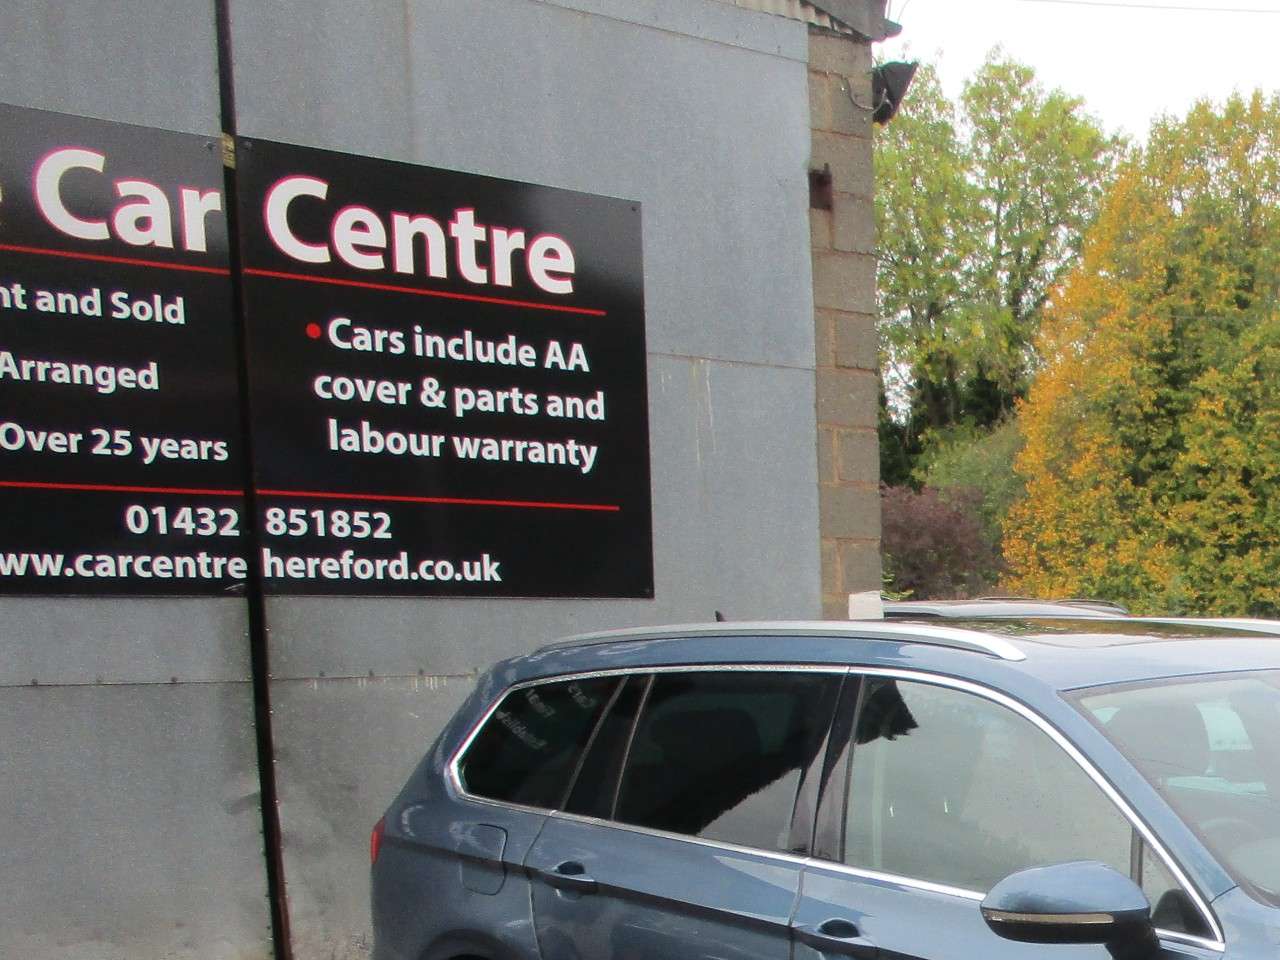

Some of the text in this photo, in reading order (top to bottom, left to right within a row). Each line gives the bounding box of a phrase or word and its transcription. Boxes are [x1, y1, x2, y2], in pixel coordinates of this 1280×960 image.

[33, 147, 577, 294] Car Centre
[35, 287, 102, 317] and
[110, 291, 186, 325] Sold
[327, 317, 591, 373] Cars include AA
[0, 350, 159, 394] Arranged
[313, 375, 605, 421] cover & parts and
[0, 422, 229, 464] Over 25 years
[328, 418, 598, 474] labour warranty
[125, 504, 393, 539] 01432 851852
